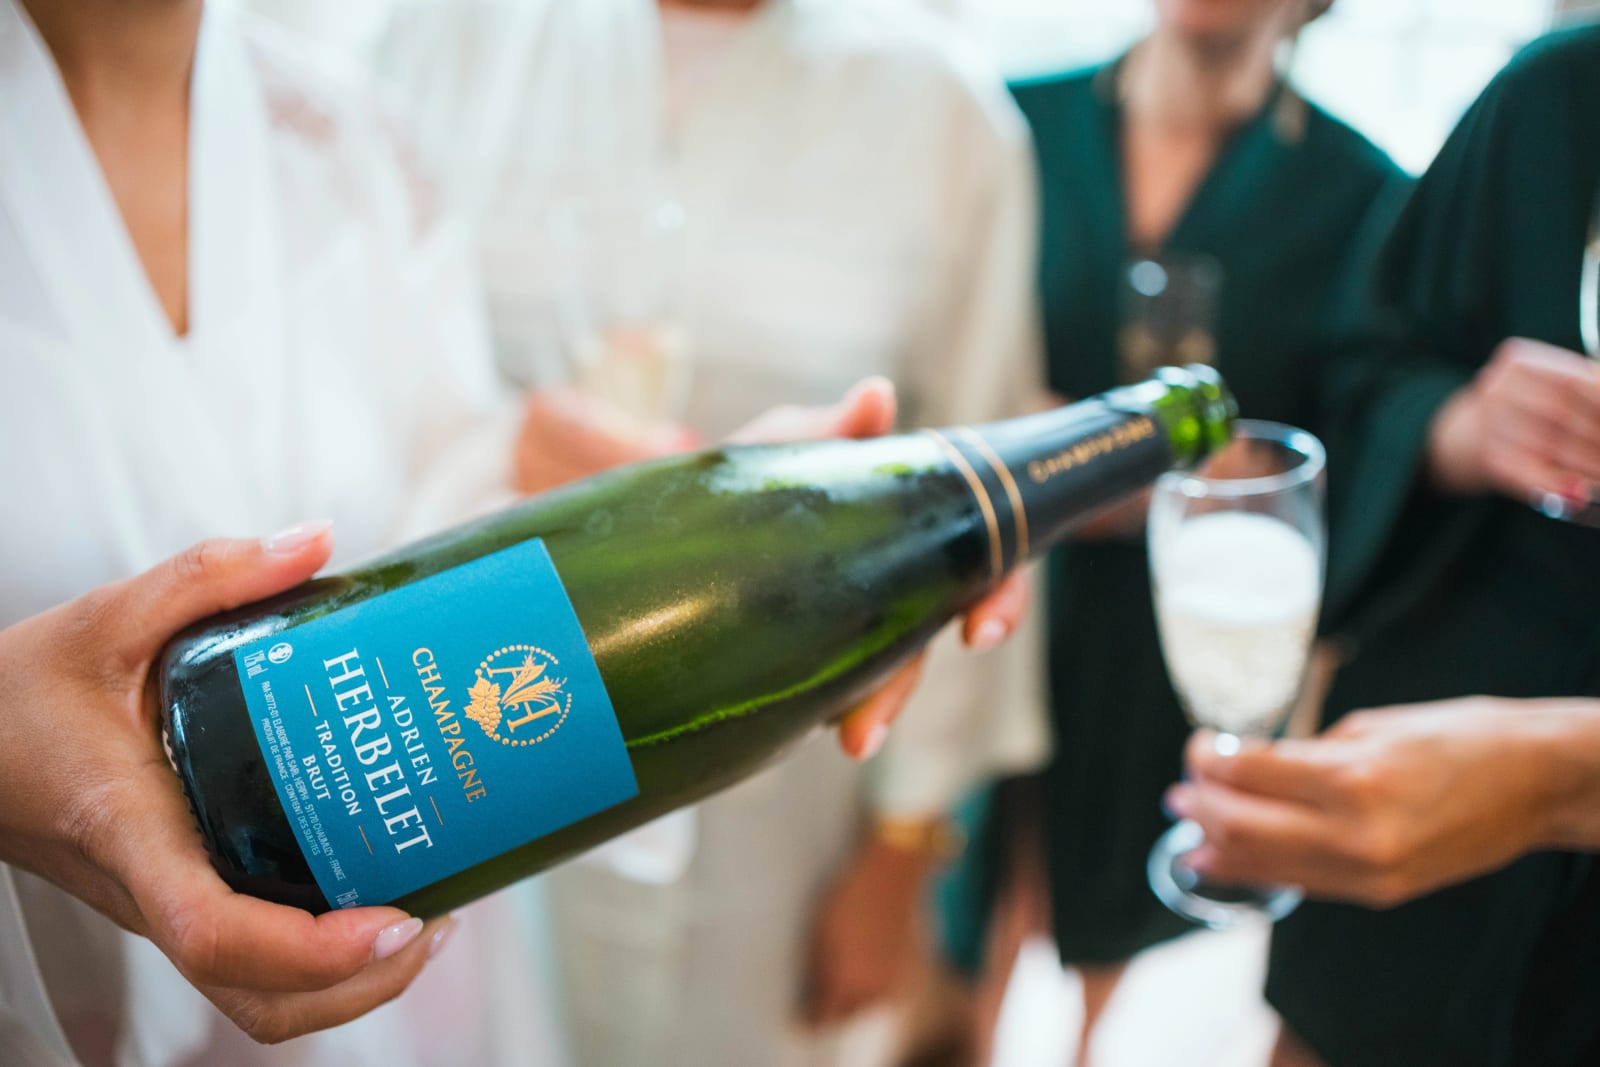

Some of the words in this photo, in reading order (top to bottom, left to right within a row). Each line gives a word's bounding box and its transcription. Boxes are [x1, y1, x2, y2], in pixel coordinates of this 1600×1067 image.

[261, 717, 277, 745] PRODUIT
[412, 647, 488, 804] CHAMPAGNE
[270, 744, 280, 756] DE
[282, 745, 295, 761] PAR
[322, 647, 434, 855] HERBELET
[387, 695, 438, 786] ADRIEN
[274, 753, 289, 781] FRANCE
[287, 759, 300, 778] SARL
[302, 753, 332, 800] BRUT
[314, 719, 363, 816] TRADITION
[284, 783, 304, 816] CONTIENT
[297, 815, 310, 830] DES
[303, 828, 321, 857] SULFITES
[328, 859, 347, 881] FRANCE
